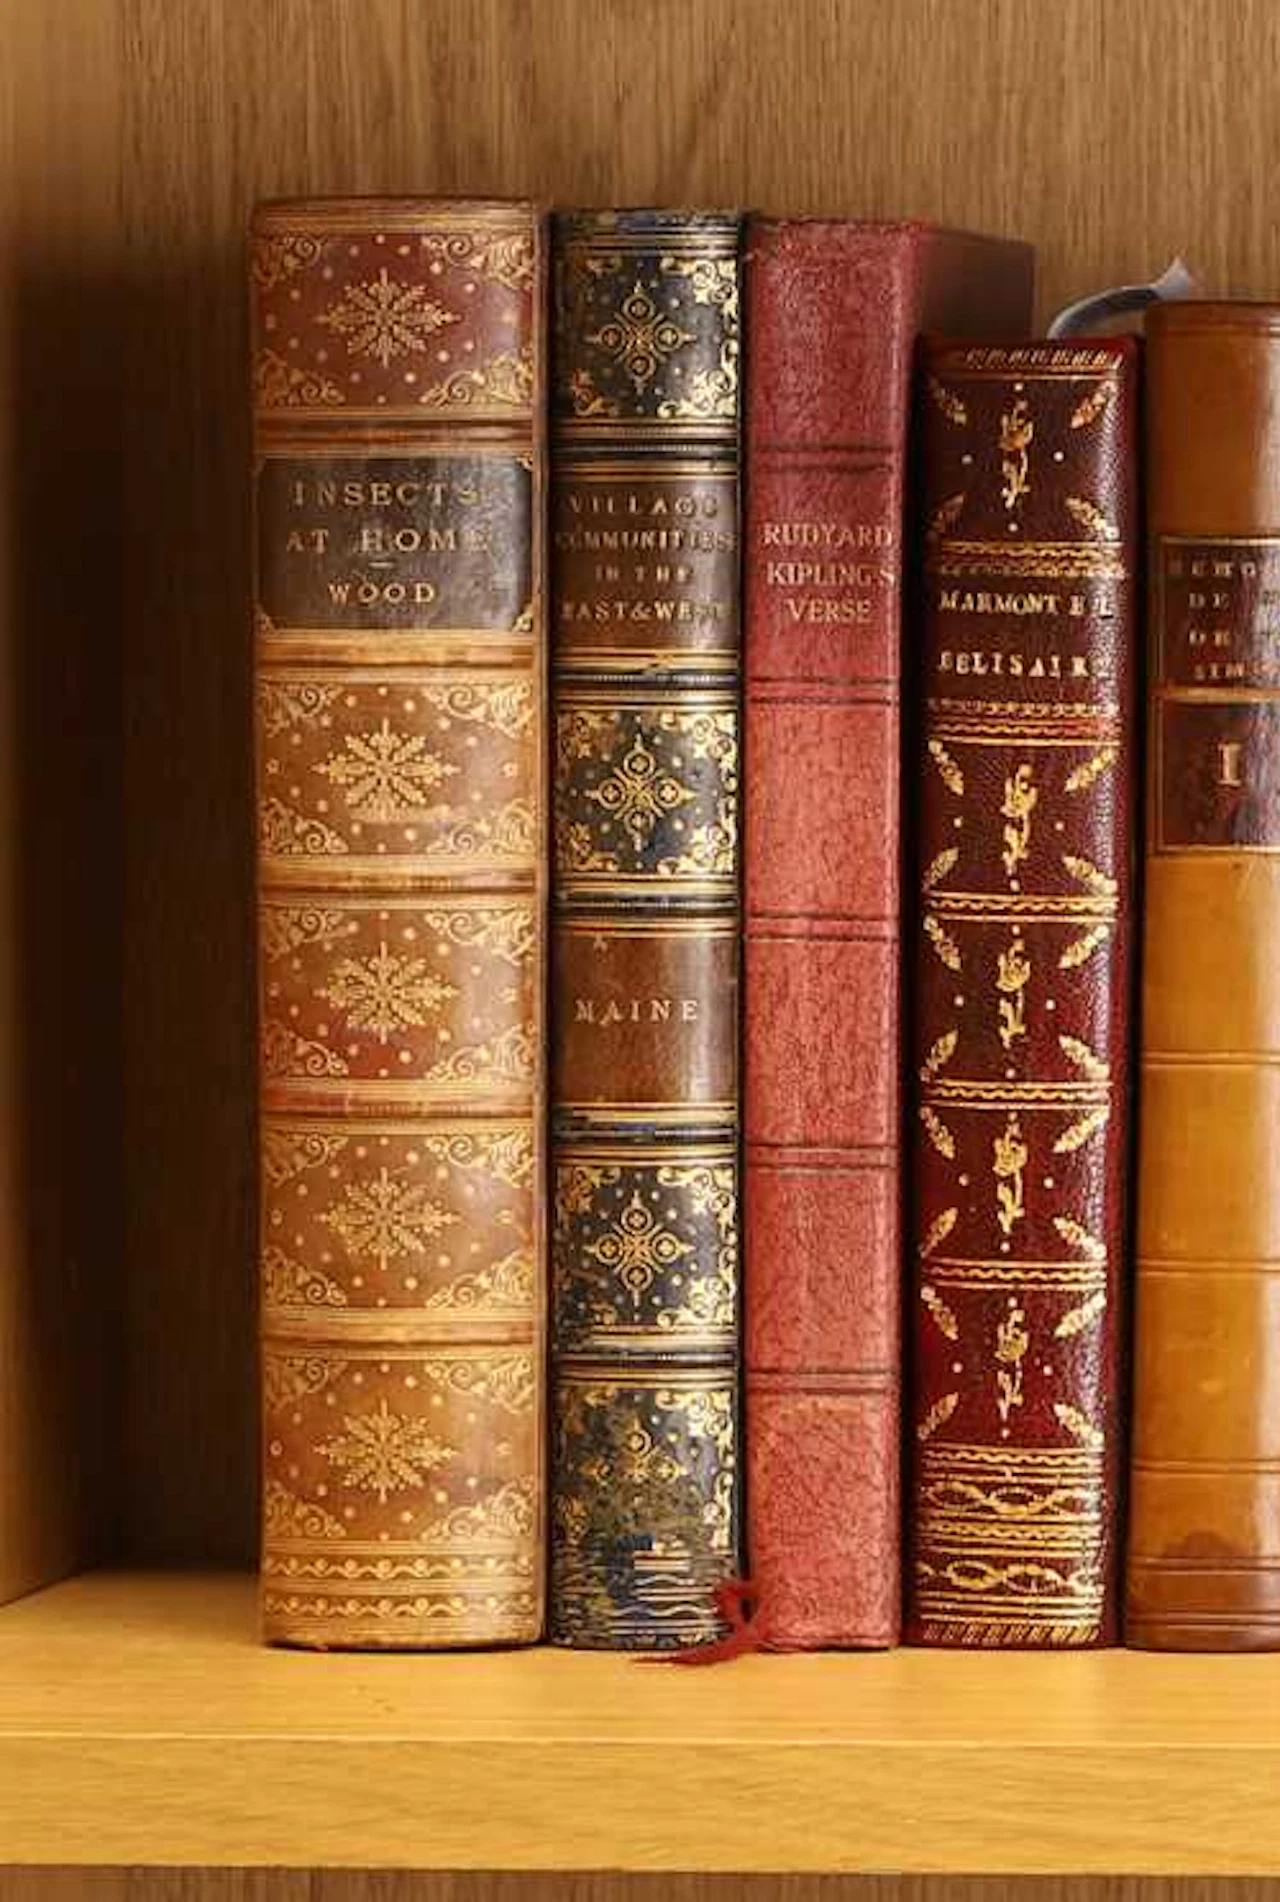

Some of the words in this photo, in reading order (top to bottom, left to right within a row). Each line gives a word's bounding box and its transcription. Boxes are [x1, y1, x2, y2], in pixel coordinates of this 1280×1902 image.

[290, 481, 483, 506] INSECTS
[286, 528, 329, 553] AT
[358, 526, 494, 552] HOME
[763, 522, 893, 547] RUDYARD
[328, 583, 436, 604] WOOD
[783, 598, 872, 623] VERSE
[574, 999, 699, 1025] MAINE
